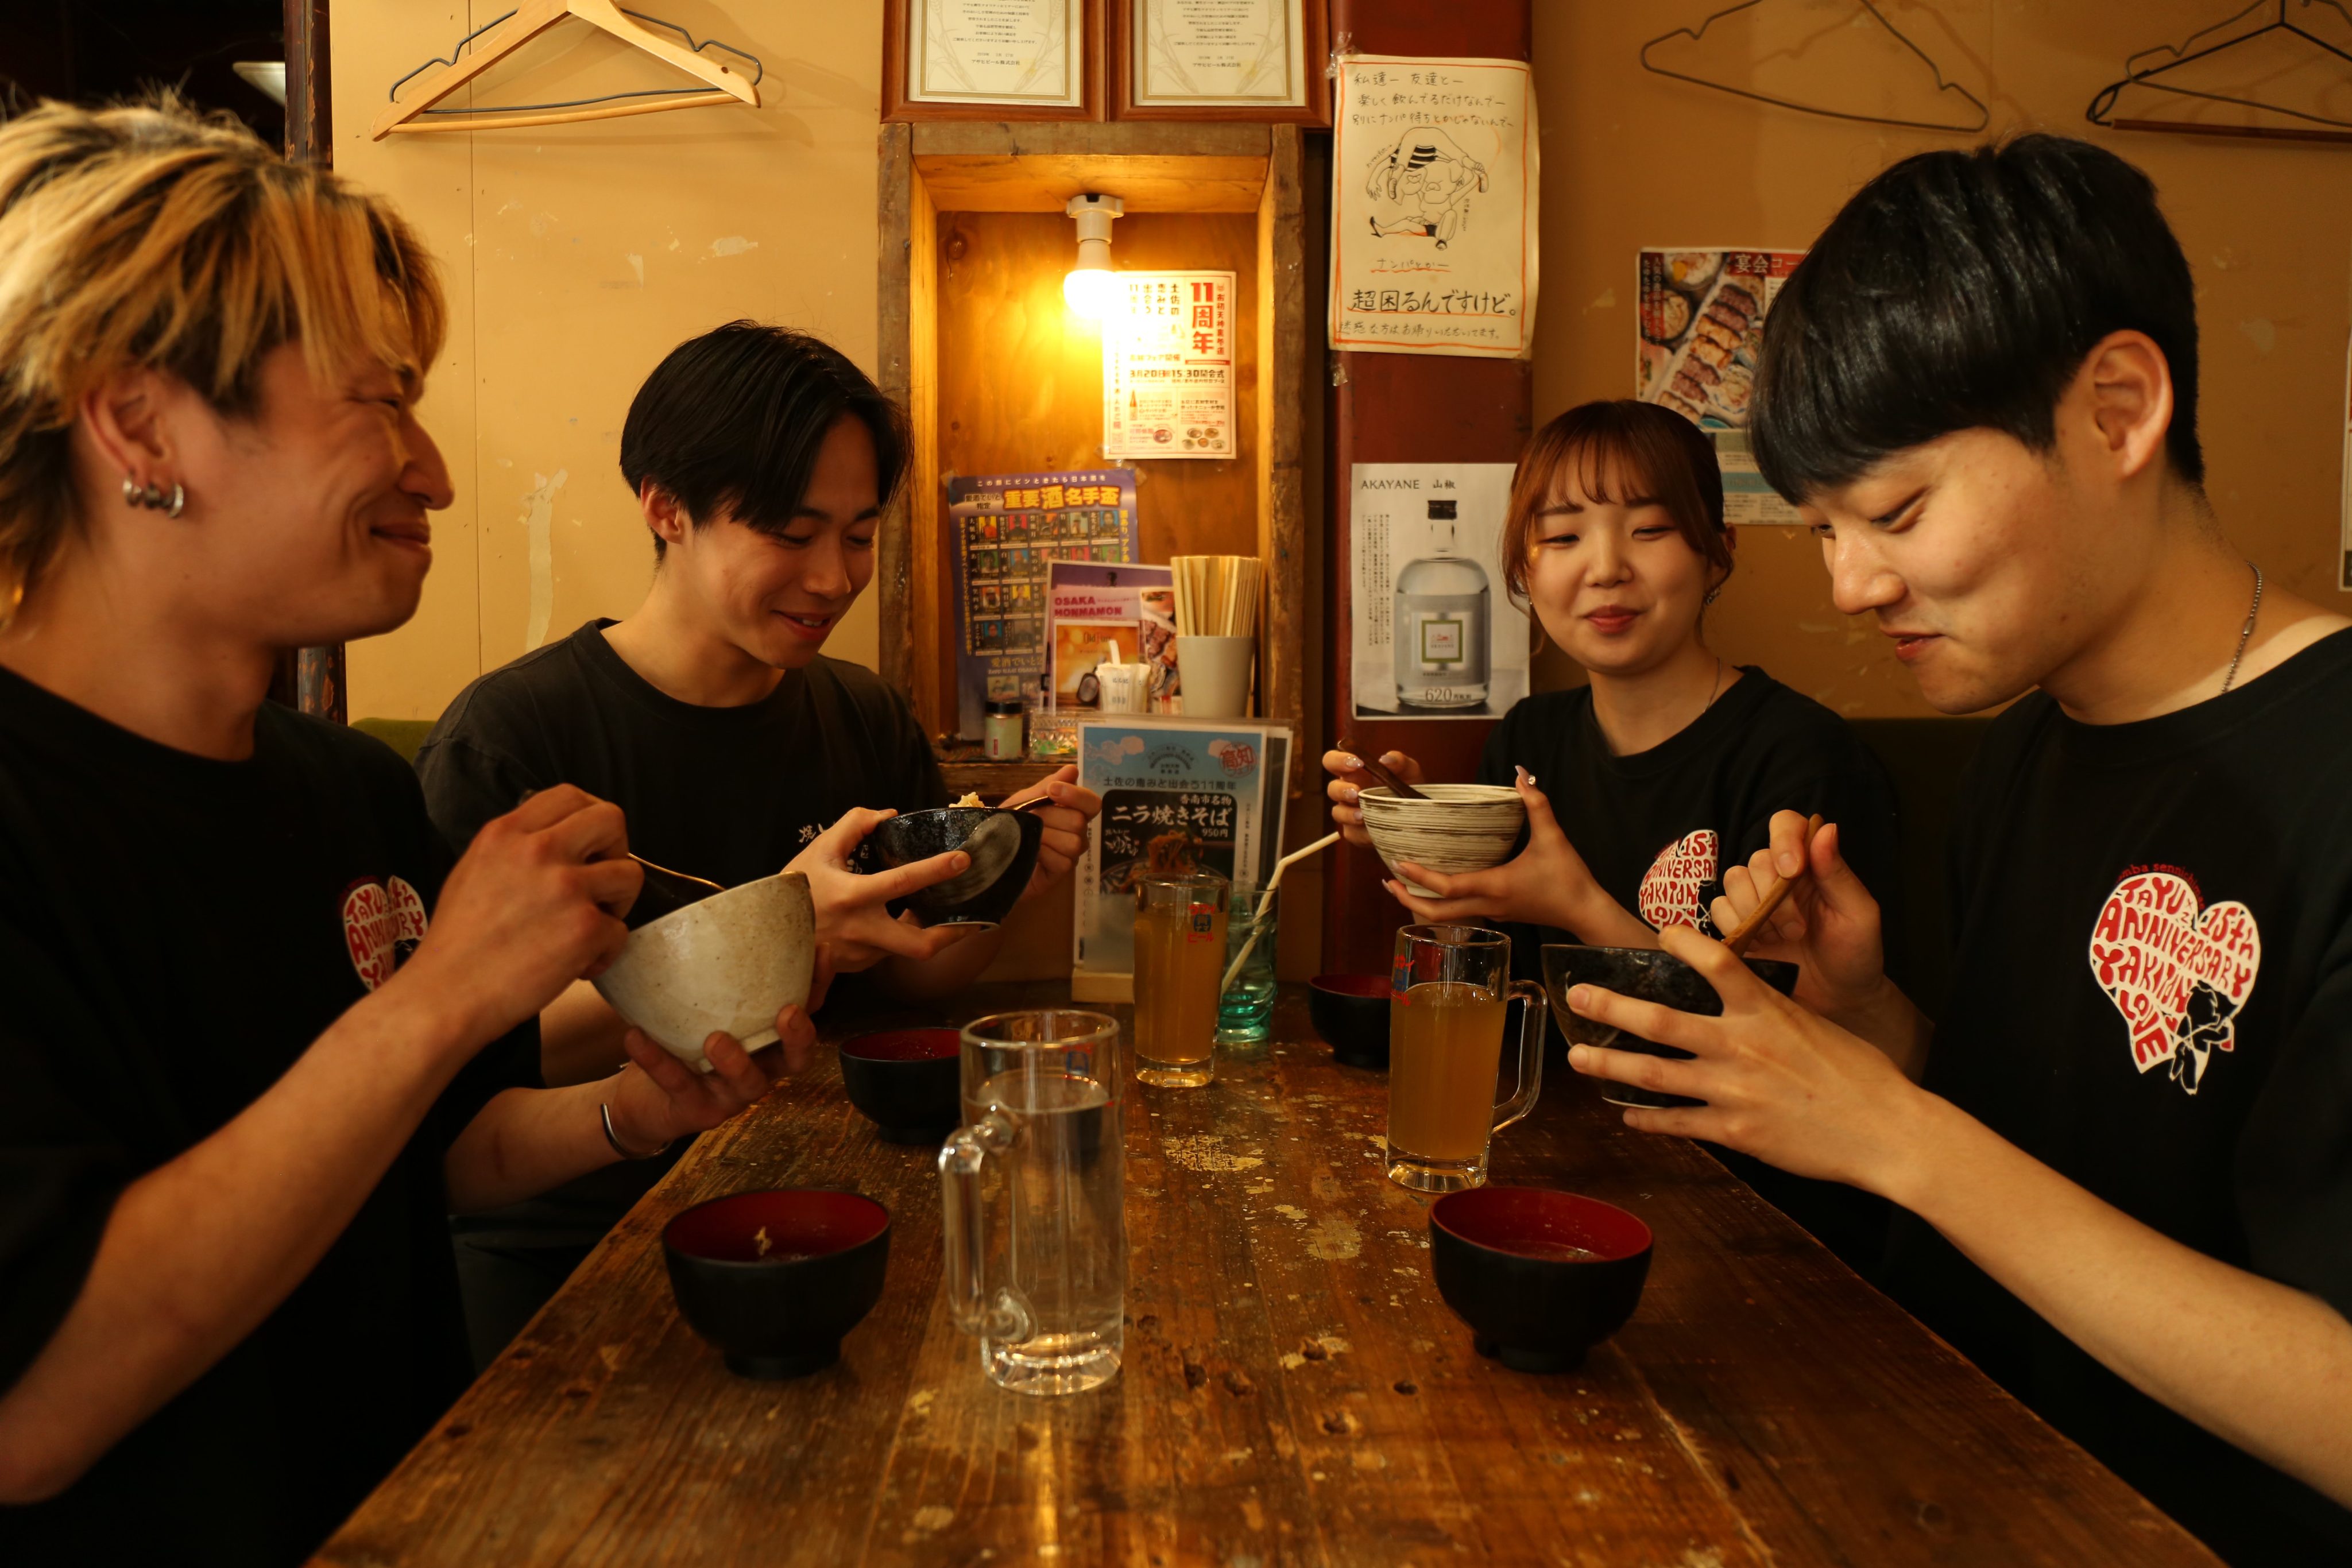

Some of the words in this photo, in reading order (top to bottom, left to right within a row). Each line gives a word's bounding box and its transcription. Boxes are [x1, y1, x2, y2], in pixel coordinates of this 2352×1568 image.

[1171, 284, 1180, 315] 土佐の
[1351, 289, 1516, 316] 超困るんですけど。
[1190, 282, 1214, 354] 11周年
[1361, 480, 1420, 489] AKAYANE
[1433, 479, 1456, 489] 山椒
[1004, 485, 1121, 510] 重要酒名手盃
[1055, 597, 1096, 606] OSAKA
[1055, 607, 1123, 616] MONMAMON
[1221, 747, 1254, 769] 高知
[1104, 777, 1237, 791] 土佐の恵みと出会う11周年
[1112, 804, 1233, 827] ニラ焼きそば
[1202, 828, 1229, 838] 950円
[1682, 833, 1717, 856] 15t
[1640, 881, 1698, 911] YAKITON
[2121, 877, 2187, 915] TAYU
[1187, 932, 1214, 943] ビール
[2200, 907, 2254, 961] 15th
[2095, 897, 2252, 998] ANNIVERSARY
[2119, 989, 2169, 1064] LOVE
